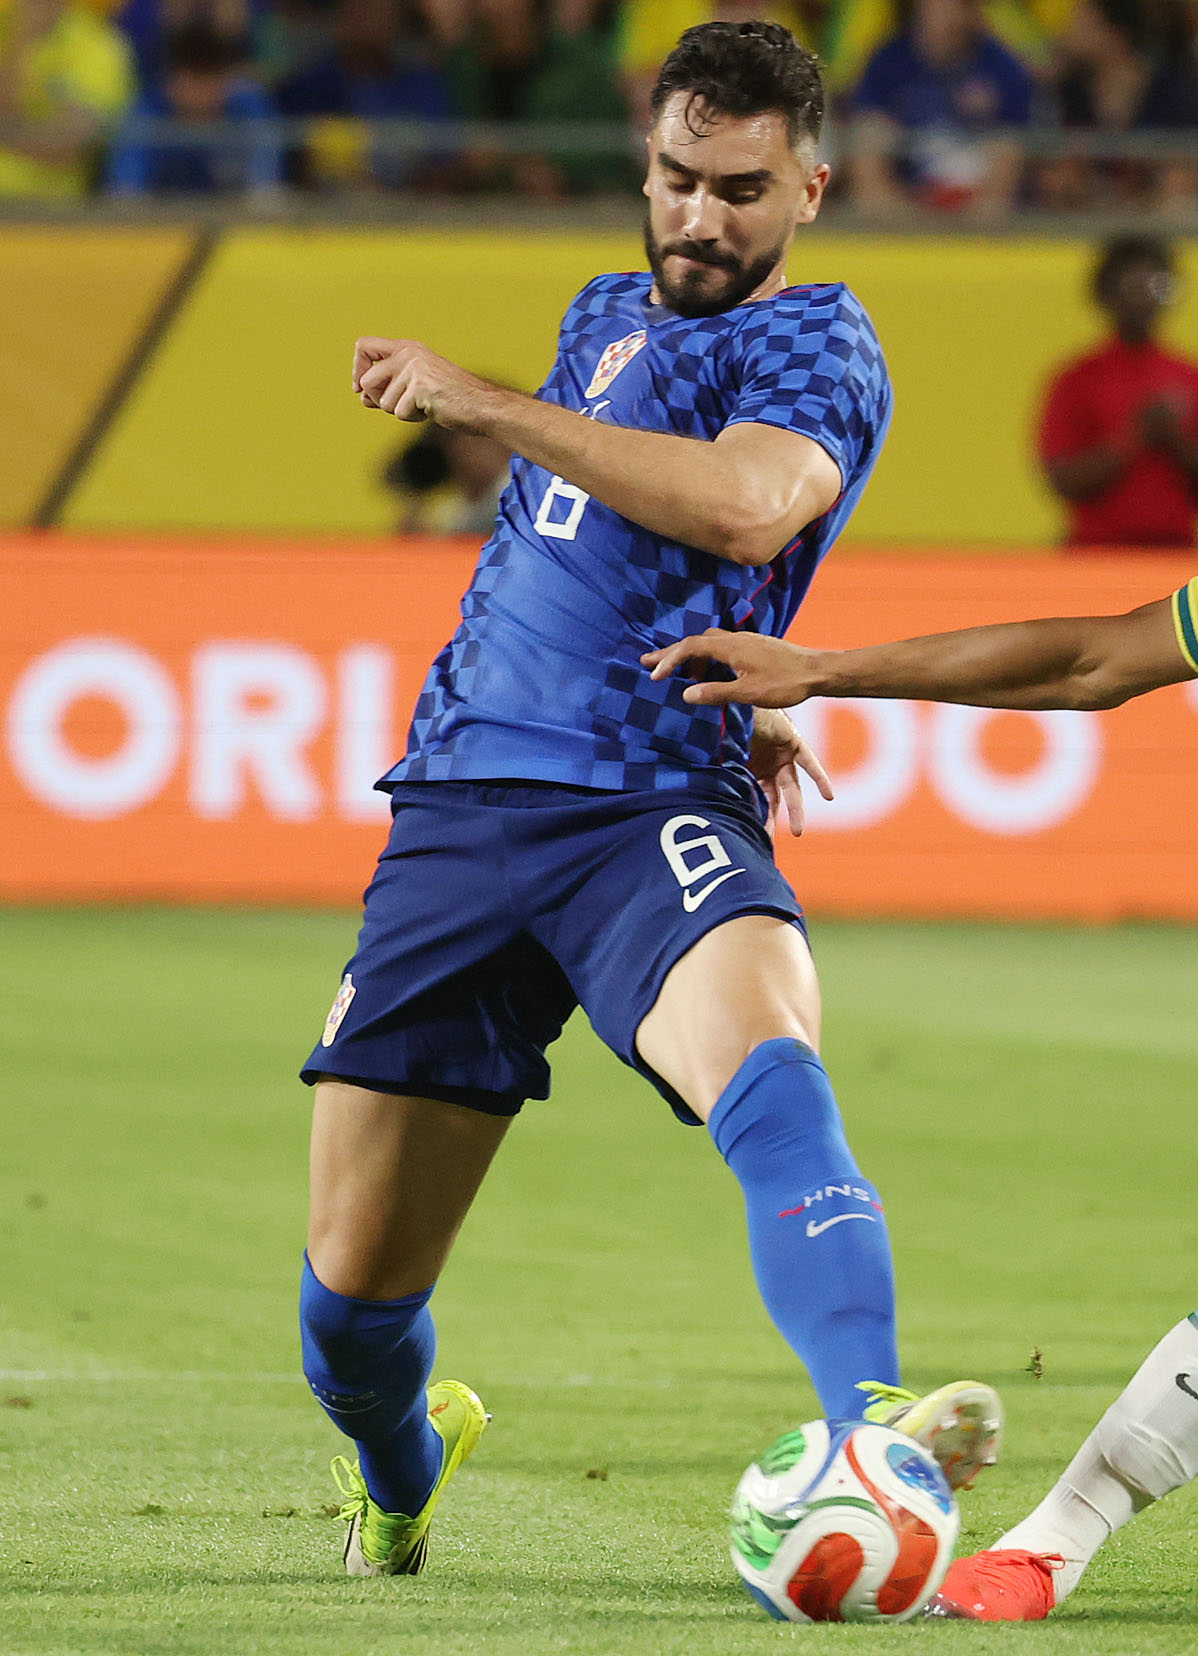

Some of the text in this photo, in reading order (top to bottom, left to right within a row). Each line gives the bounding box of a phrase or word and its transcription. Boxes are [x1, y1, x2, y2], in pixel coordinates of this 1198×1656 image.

[8, 637, 1100, 833] ORLDO
[660, 814, 733, 888] 6
[803, 1184, 870, 1208] HNS
